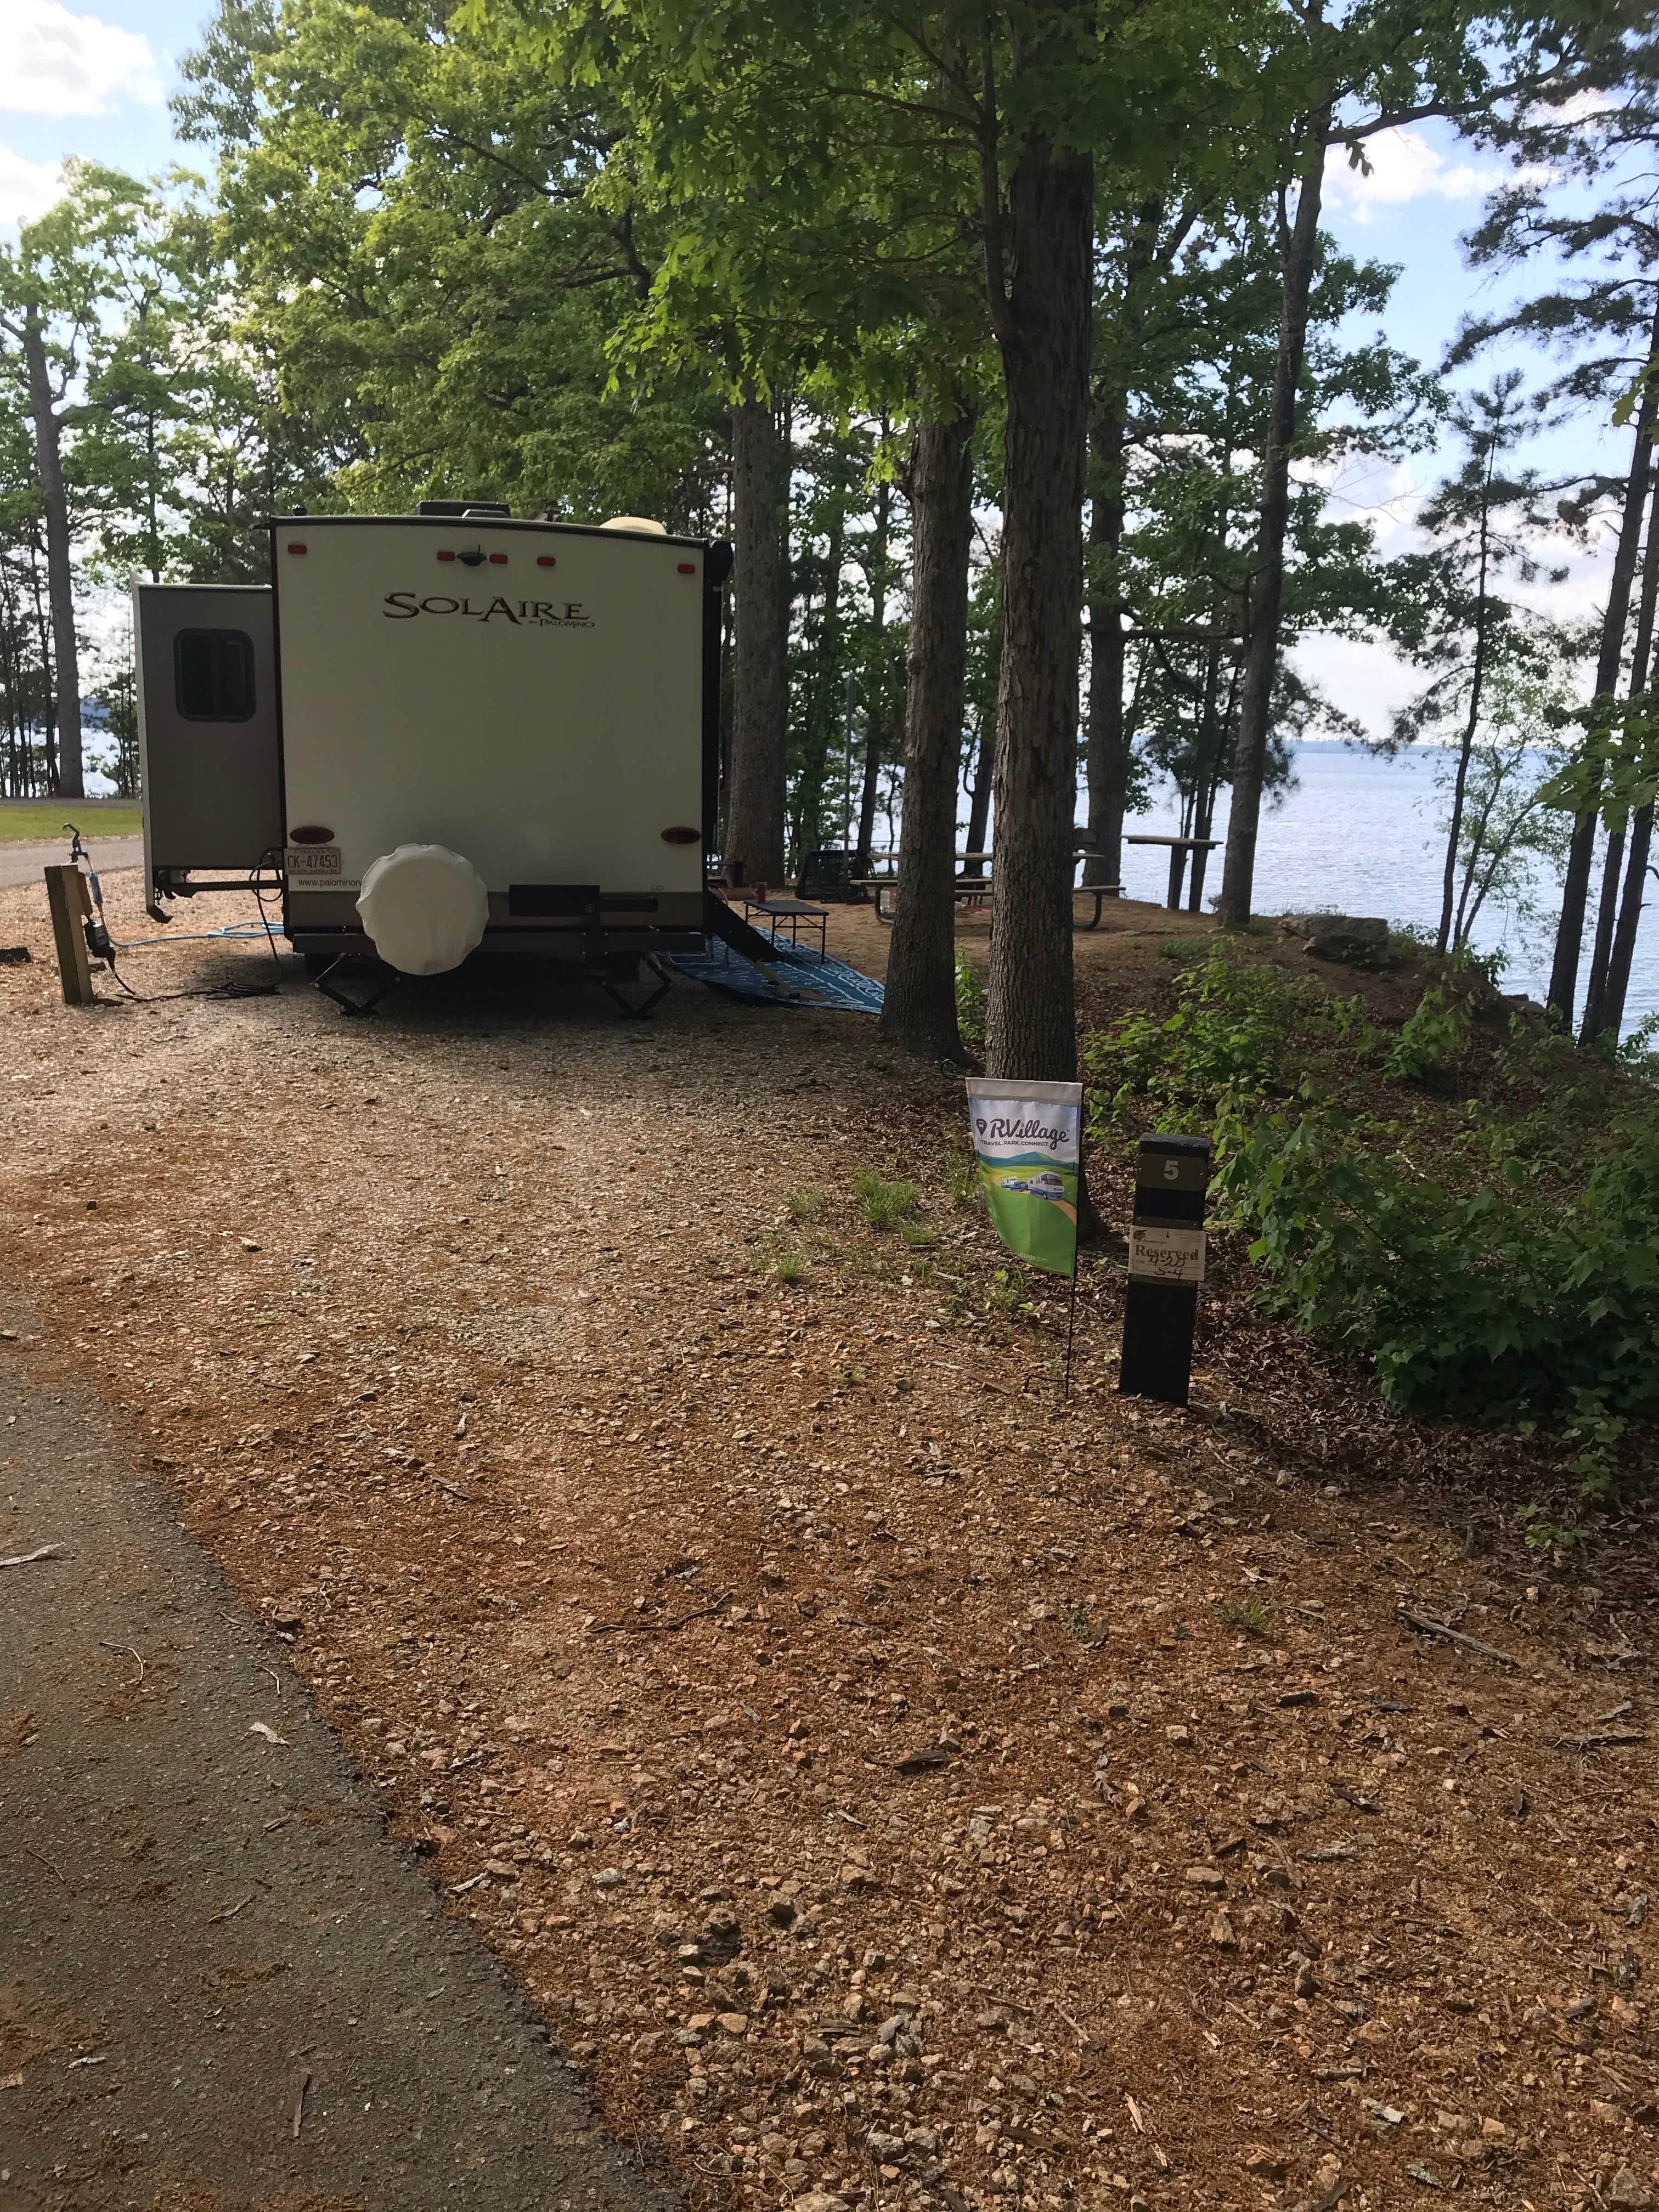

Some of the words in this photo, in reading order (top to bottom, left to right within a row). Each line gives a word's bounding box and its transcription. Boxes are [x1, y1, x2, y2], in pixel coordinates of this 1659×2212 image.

[287, 855, 338, 868] CK-47453
[990, 1118, 1070, 1150] RVillage
[1164, 1160, 1178, 1180] 5
[1135, 1244, 1199, 1261] Reserved
